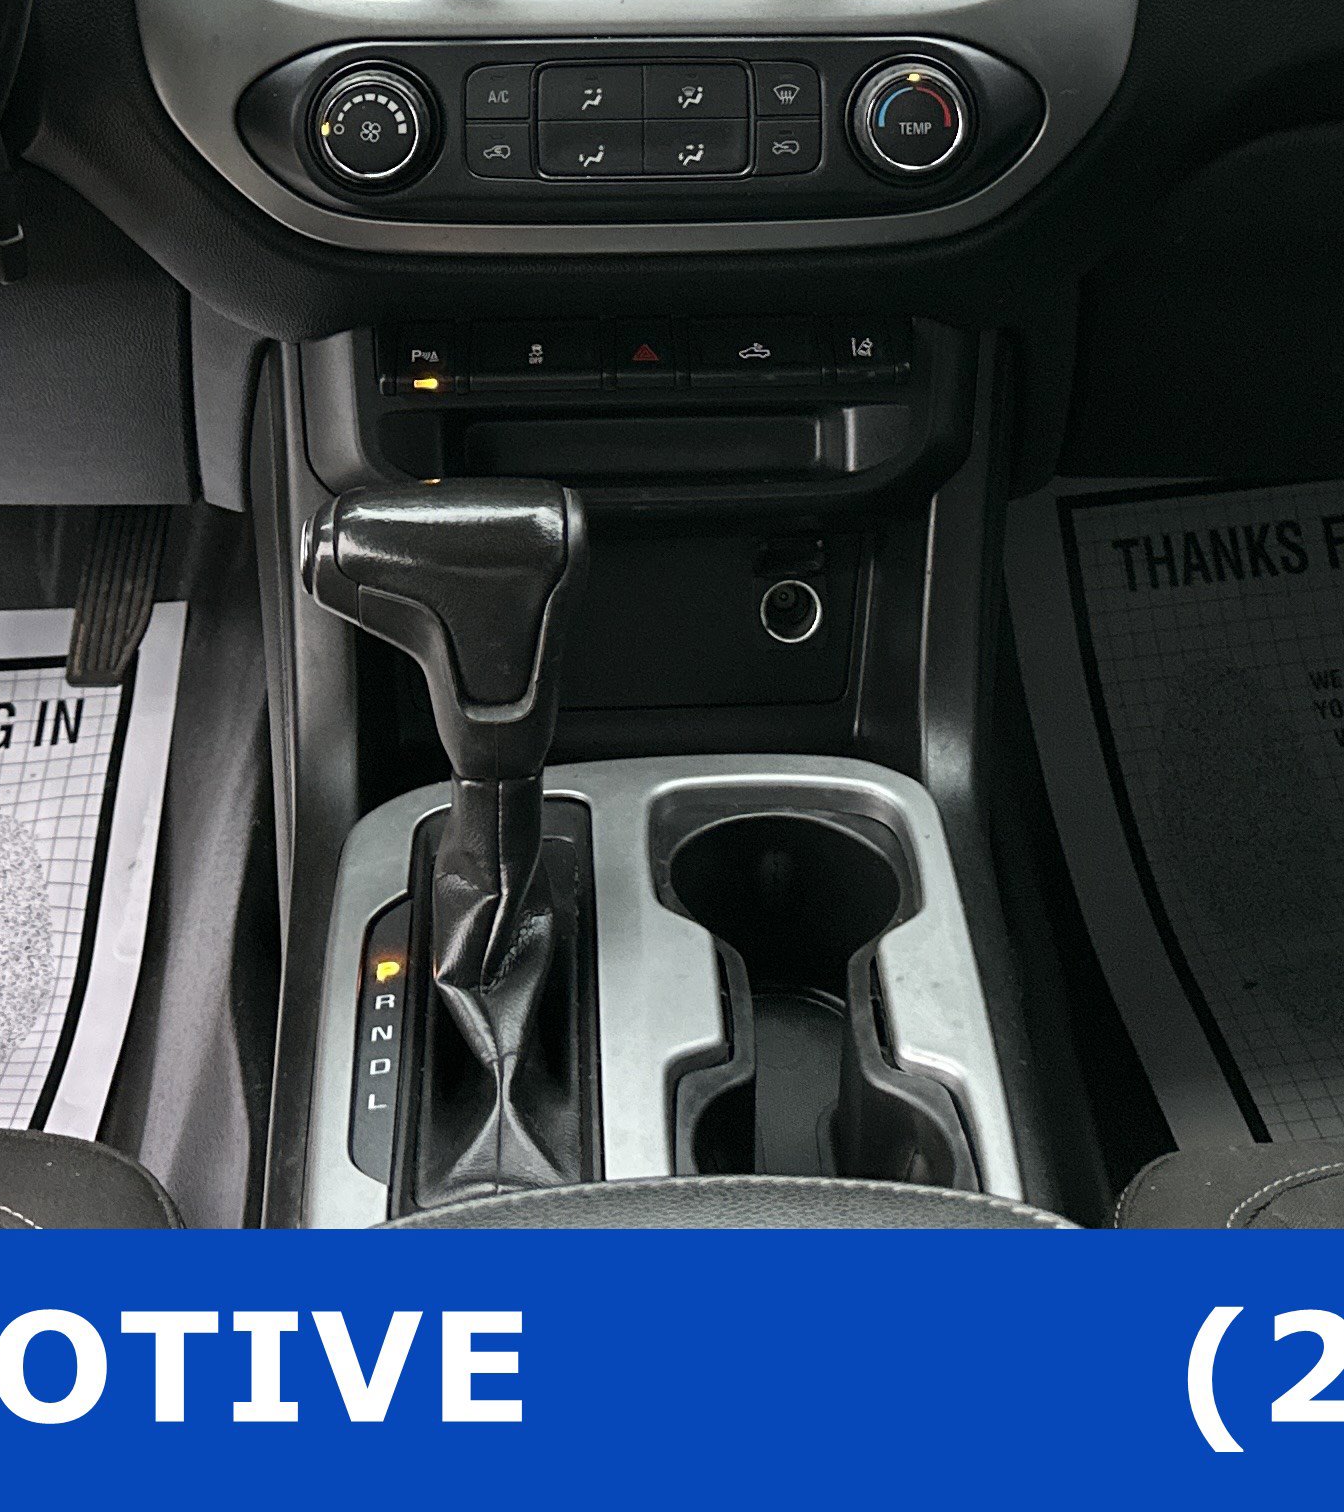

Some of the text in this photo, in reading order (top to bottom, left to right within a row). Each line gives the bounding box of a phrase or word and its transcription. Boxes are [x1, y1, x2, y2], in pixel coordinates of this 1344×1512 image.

[487, 89, 510, 106] A/C
[899, 120, 932, 136] TEMP
[1113, 519, 1309, 591] THANKS
[1308, 668, 1342, 692] WE
[32, 697, 86, 748] IN
[376, 960, 400, 983] P
[375, 993, 396, 1011] R
[371, 1024, 393, 1043] N
[369, 1058, 391, 1076] D
[367, 1093, 388, 1111] L
